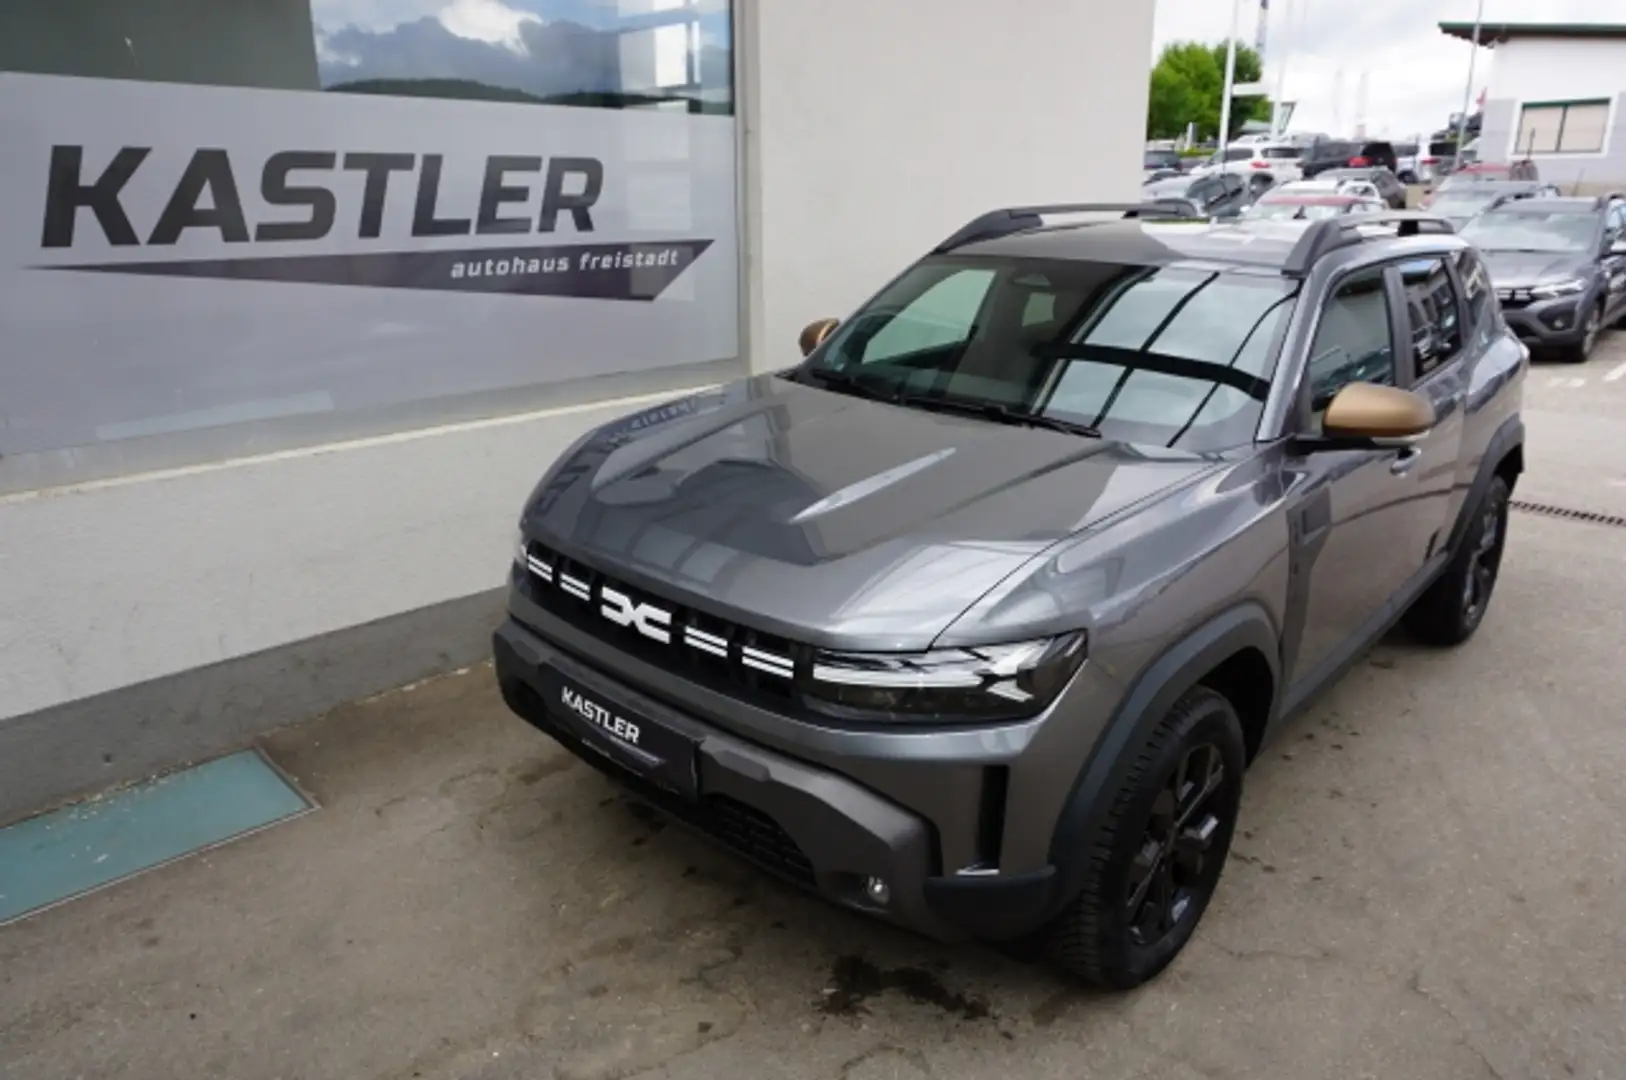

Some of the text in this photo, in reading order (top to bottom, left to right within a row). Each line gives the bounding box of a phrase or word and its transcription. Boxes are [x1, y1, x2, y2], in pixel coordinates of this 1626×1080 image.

[41, 145, 603, 247] KASTLER
[451, 250, 678, 278] autohaus freistadt
[561, 686, 640, 743] KASTLER
